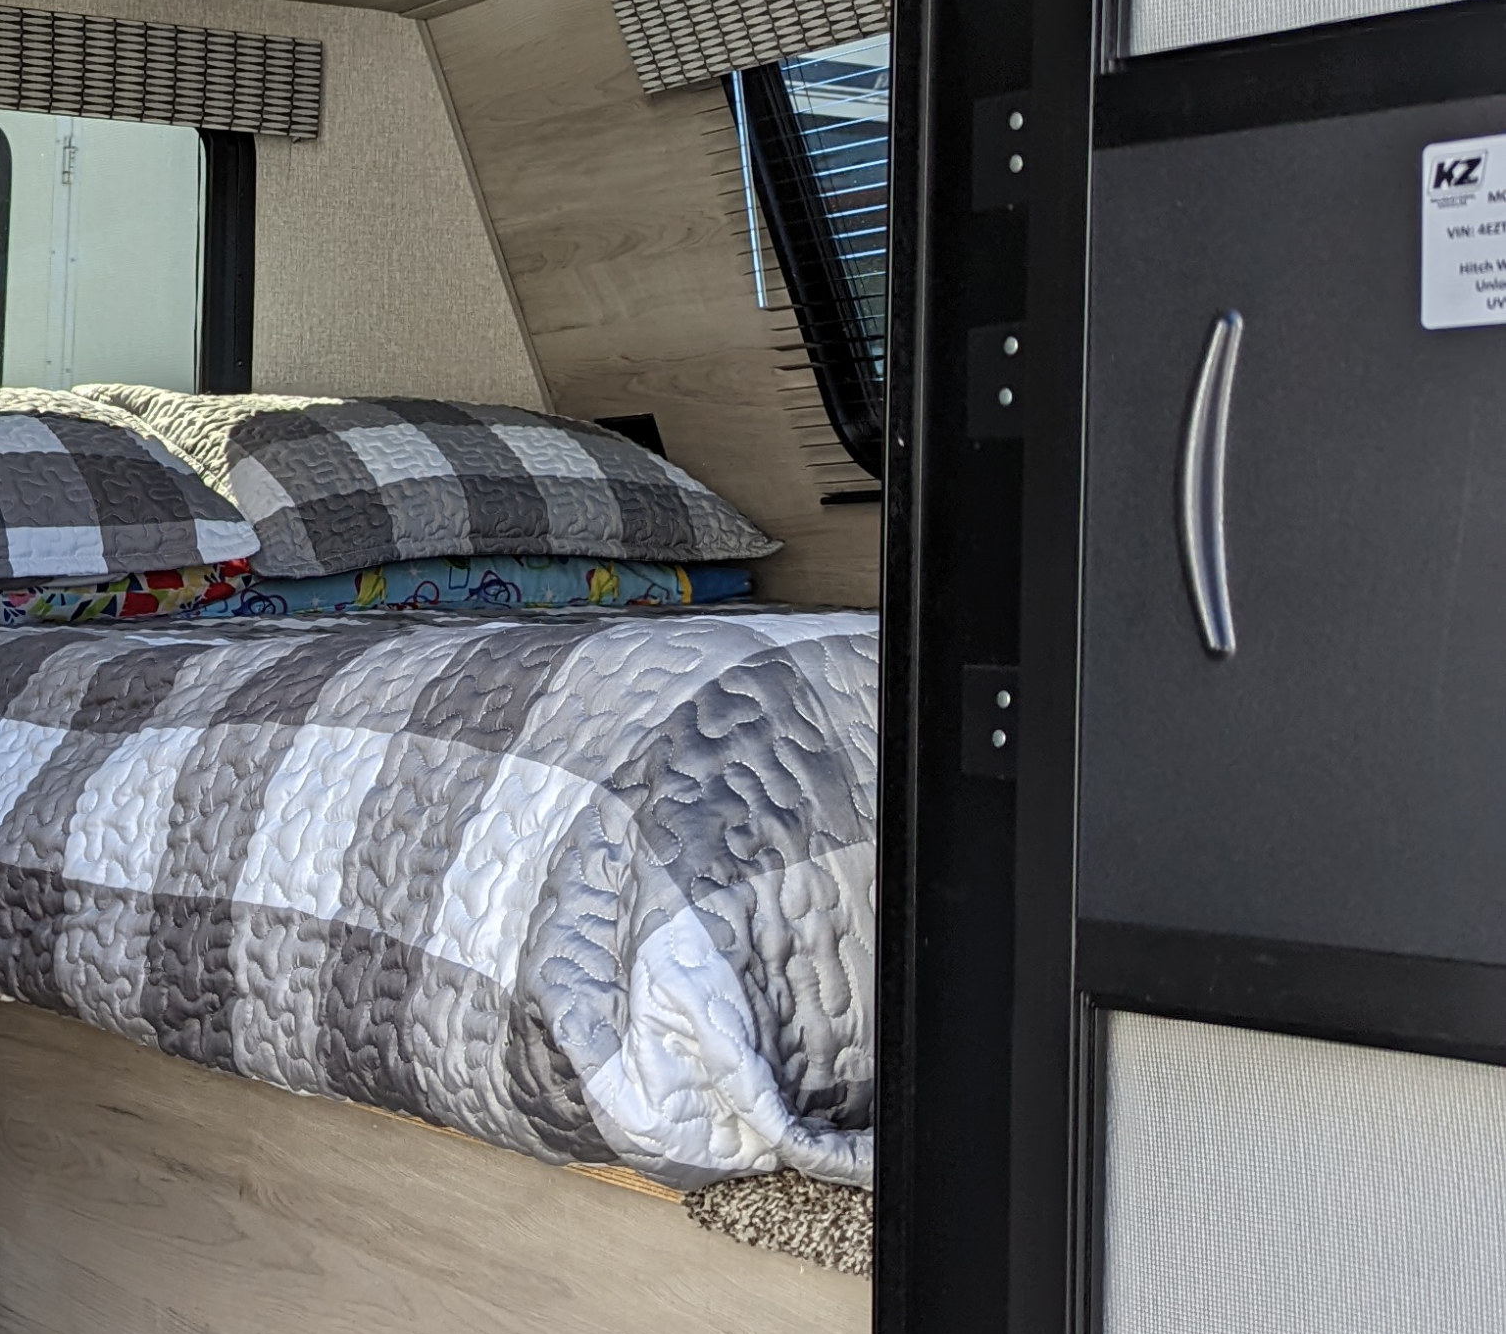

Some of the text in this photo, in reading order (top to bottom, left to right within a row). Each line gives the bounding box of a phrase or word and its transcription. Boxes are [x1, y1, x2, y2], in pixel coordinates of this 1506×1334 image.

[1433, 157, 1482, 188] KZ
[1459, 259, 1493, 275] Hitch
[1486, 296, 1506, 311] UV
